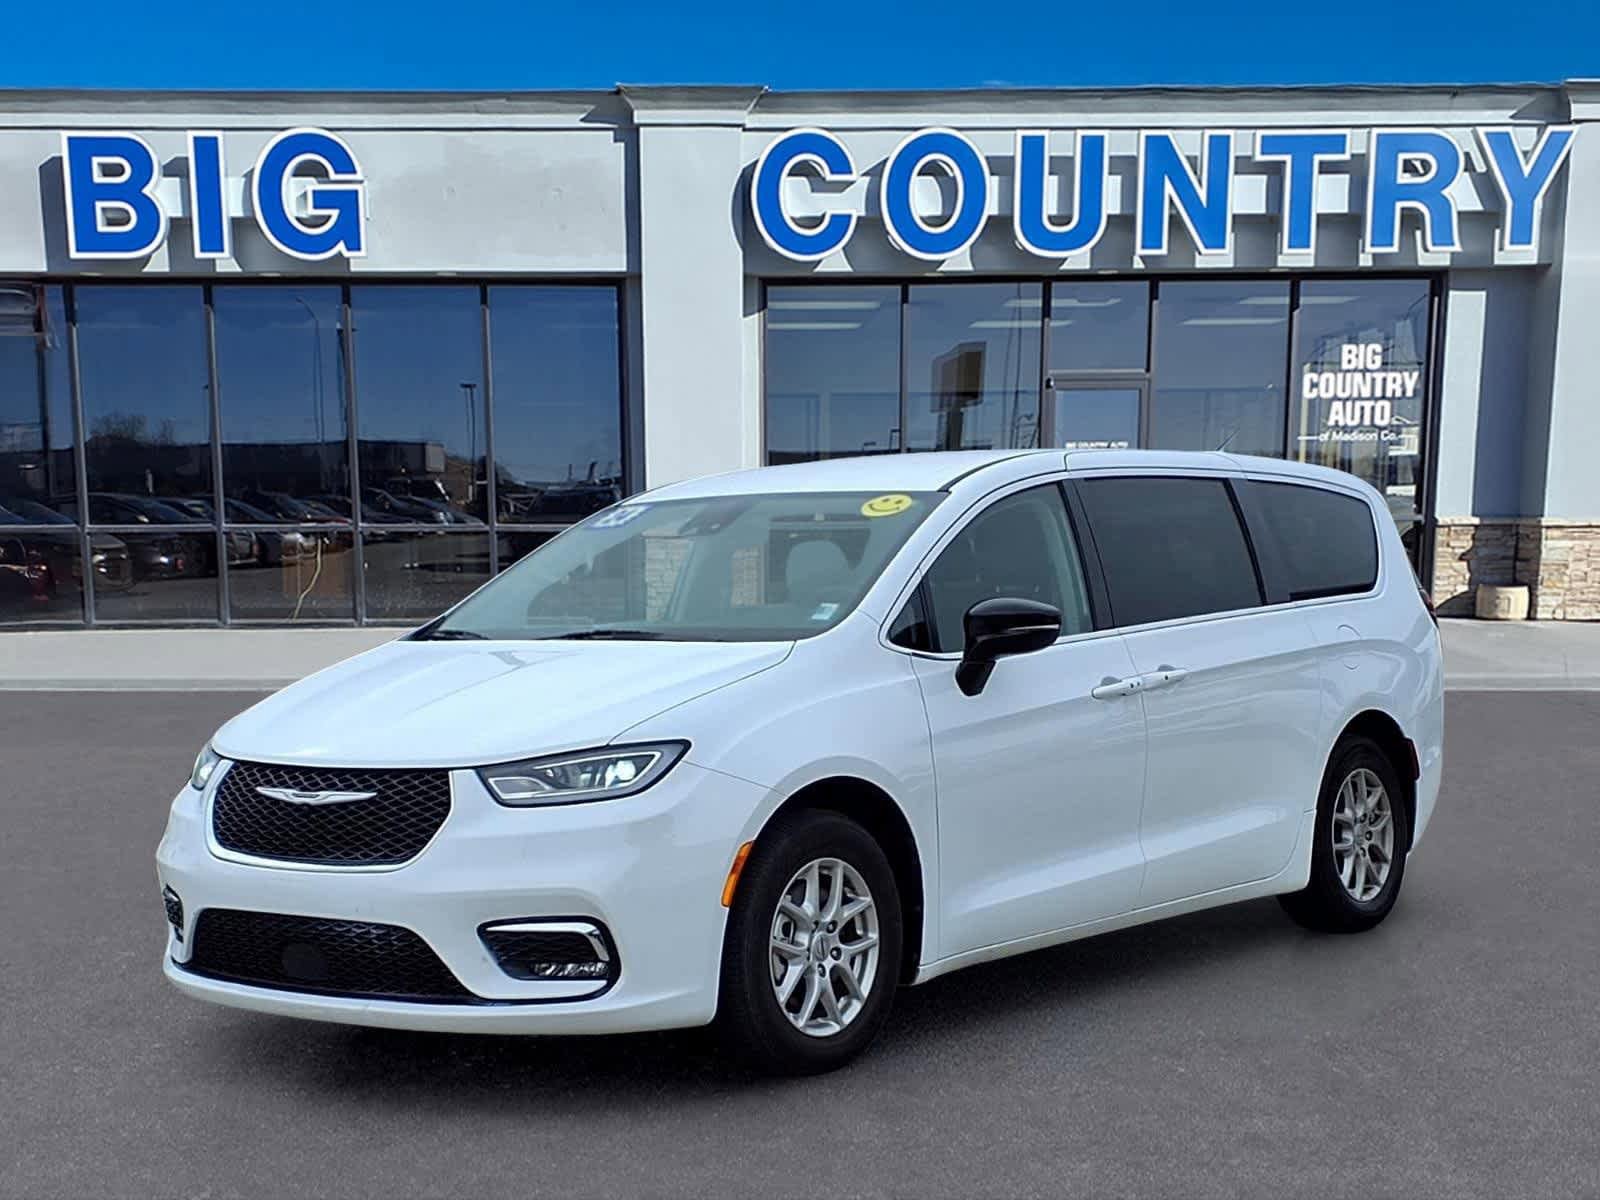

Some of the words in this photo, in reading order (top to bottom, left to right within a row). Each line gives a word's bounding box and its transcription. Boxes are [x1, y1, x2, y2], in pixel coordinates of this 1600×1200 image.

[61, 127, 367, 261] BIG
[750, 127, 1573, 261] COUNTRY
[1341, 344, 1382, 370] BIG
[1302, 371, 1419, 399] COUNTRY
[1327, 400, 1391, 426] AUTO
[1320, 431, 1329, 442] of
[1332, 431, 1378, 441] Madison
